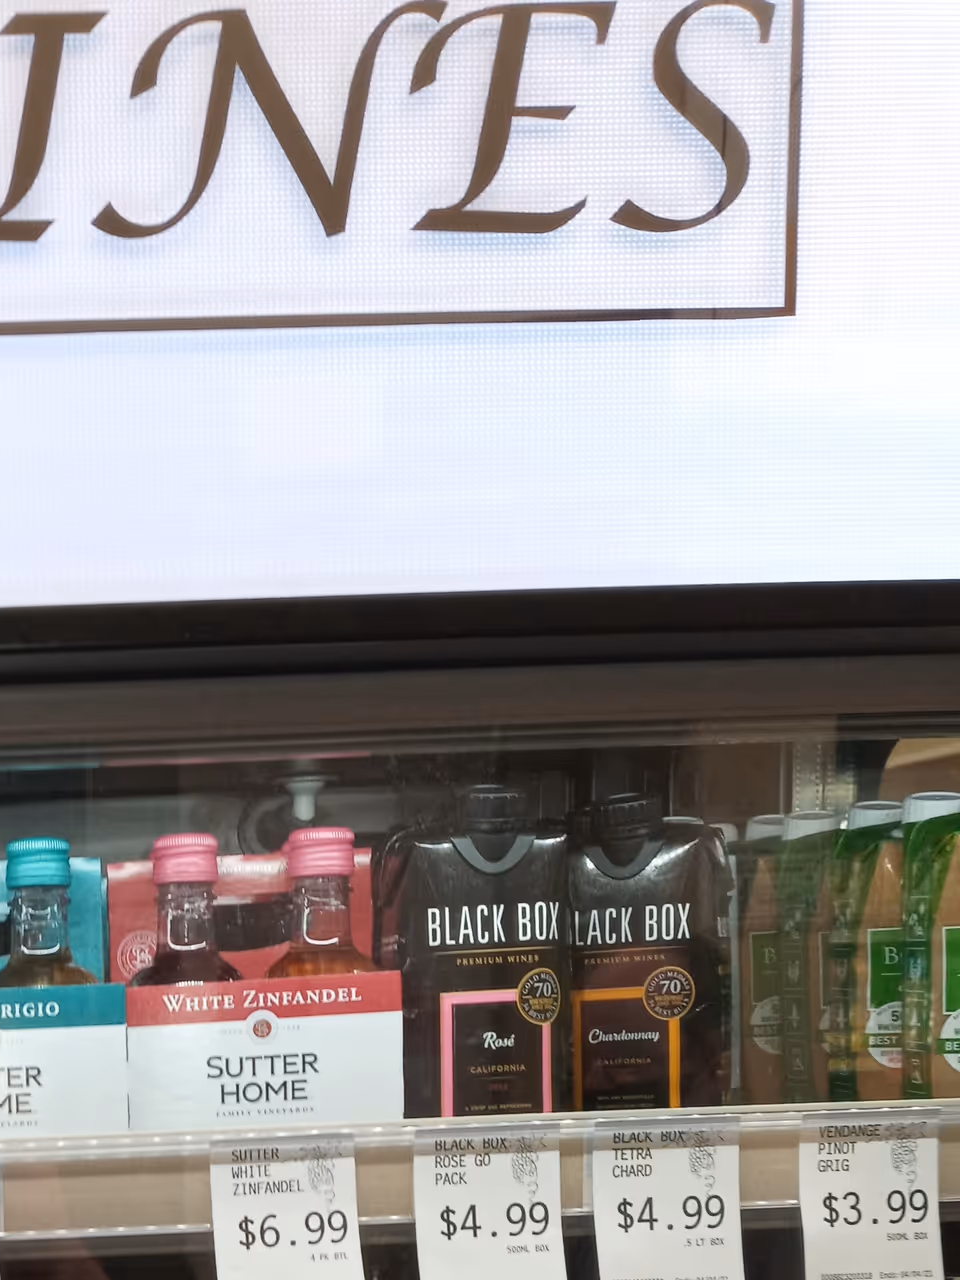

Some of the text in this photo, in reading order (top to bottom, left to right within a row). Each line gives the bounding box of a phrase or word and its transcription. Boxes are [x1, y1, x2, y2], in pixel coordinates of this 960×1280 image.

[427, 901, 560, 946] BLACK BOX
[645, 903, 690, 941] BOX
[456, 954, 540, 966] PREMIUM WINES
[533, 982, 552, 997] 70
[659, 980, 681, 994] 70
[162, 987, 362, 1012] WHITE ZINFANDEL
[482, 1031, 515, 1050] Rosé
[588, 1028, 661, 1044] Chardonnay
[869, 1036, 898, 1046] BEST
[206, 1054, 320, 1079] SUTTER
[470, 1064, 527, 1074] CALIFORNIA
[220, 1080, 308, 1104] HOME
[612, 1131, 653, 1144] BLACK
[819, 1124, 881, 1138] VENDANGE
[434, 1136, 508, 1151] BLACK BOX
[818, 1141, 857, 1155] PINOT
[231, 1147, 280, 1162] SUTTER
[435, 1153, 491, 1168] ROSE GO
[612, 1147, 653, 1161] TETRA
[231, 1164, 271, 1179] WHITE
[612, 1164, 653, 1178] CHARD
[817, 1159, 850, 1173] GRIG
[435, 1172, 467, 1186] PACK
[233, 1180, 304, 1196] ZINFANDEL
[617, 1195, 725, 1233] $4.99
[823, 1189, 928, 1228] $3.99
[440, 1201, 549, 1240] $4.99
[239, 1210, 348, 1250] $6.99
